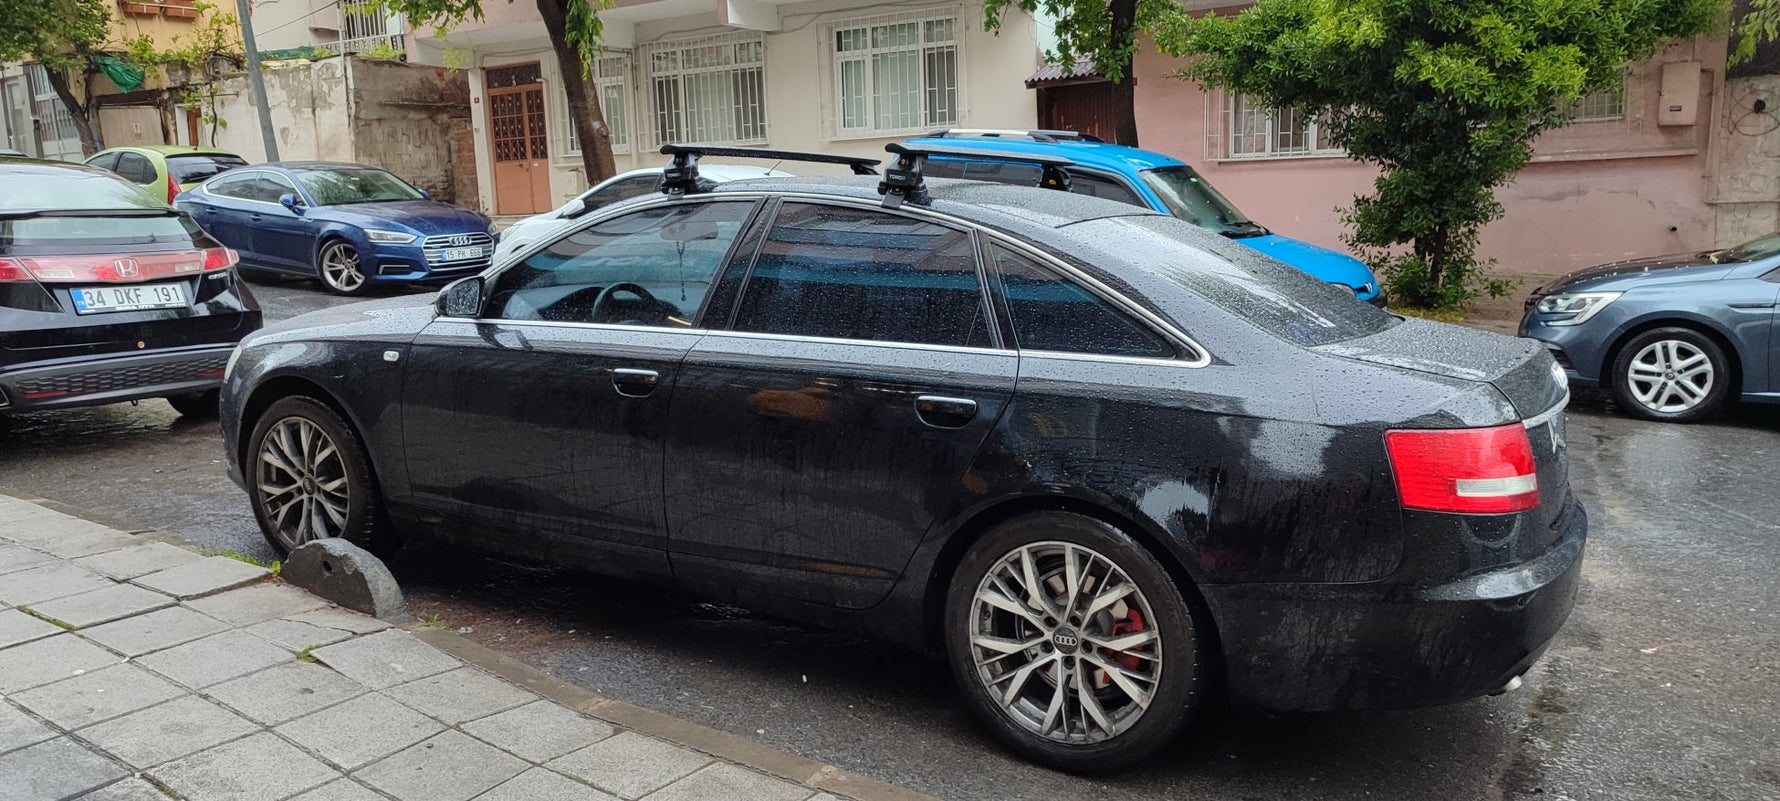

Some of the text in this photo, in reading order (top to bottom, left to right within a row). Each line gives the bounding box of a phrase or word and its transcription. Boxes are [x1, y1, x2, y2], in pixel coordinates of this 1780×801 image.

[84, 286, 181, 307] 34 DKF 191
